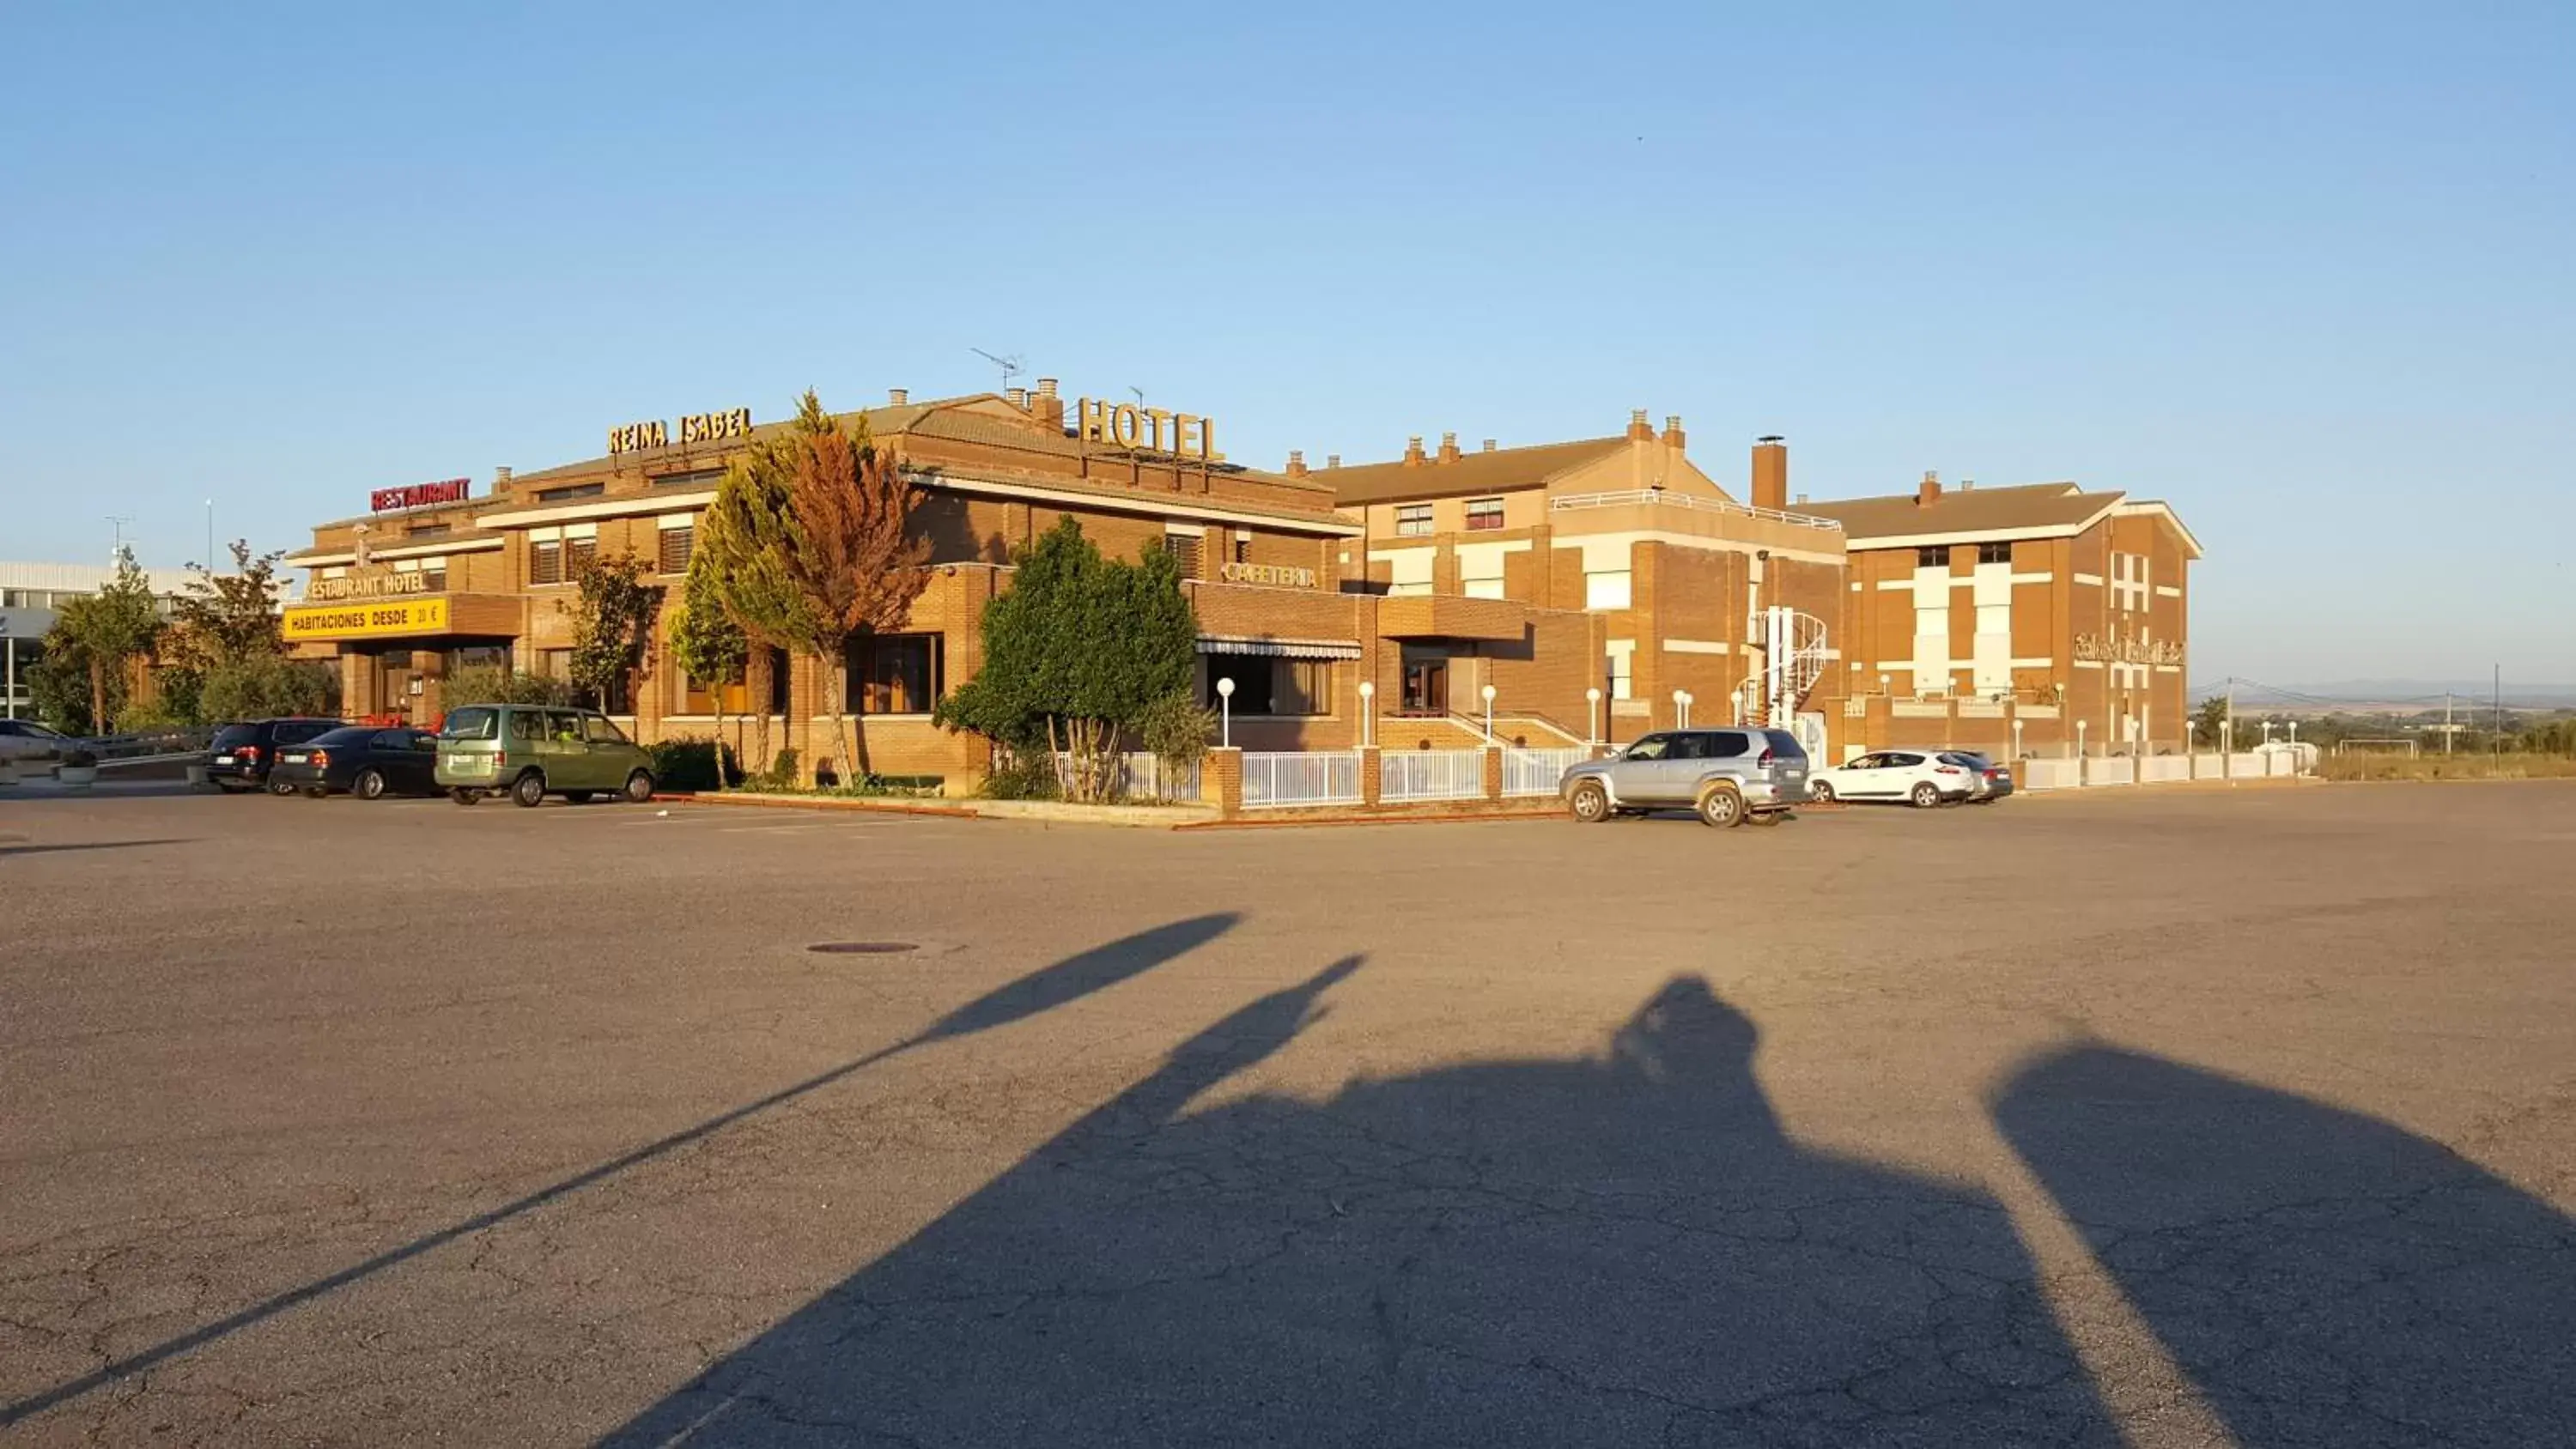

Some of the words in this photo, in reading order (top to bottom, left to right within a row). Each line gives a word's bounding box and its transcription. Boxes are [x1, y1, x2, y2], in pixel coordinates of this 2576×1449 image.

[609, 420, 669, 453] REINA
[681, 407, 754, 444] ISABEL
[1078, 397, 1226, 461] HOTEL
[371, 477, 471, 512] RESTAURANT
[386, 573, 425, 593] HOTEL
[292, 613, 365, 631] HABITACIONES
[373, 609, 408, 626] DESDE
